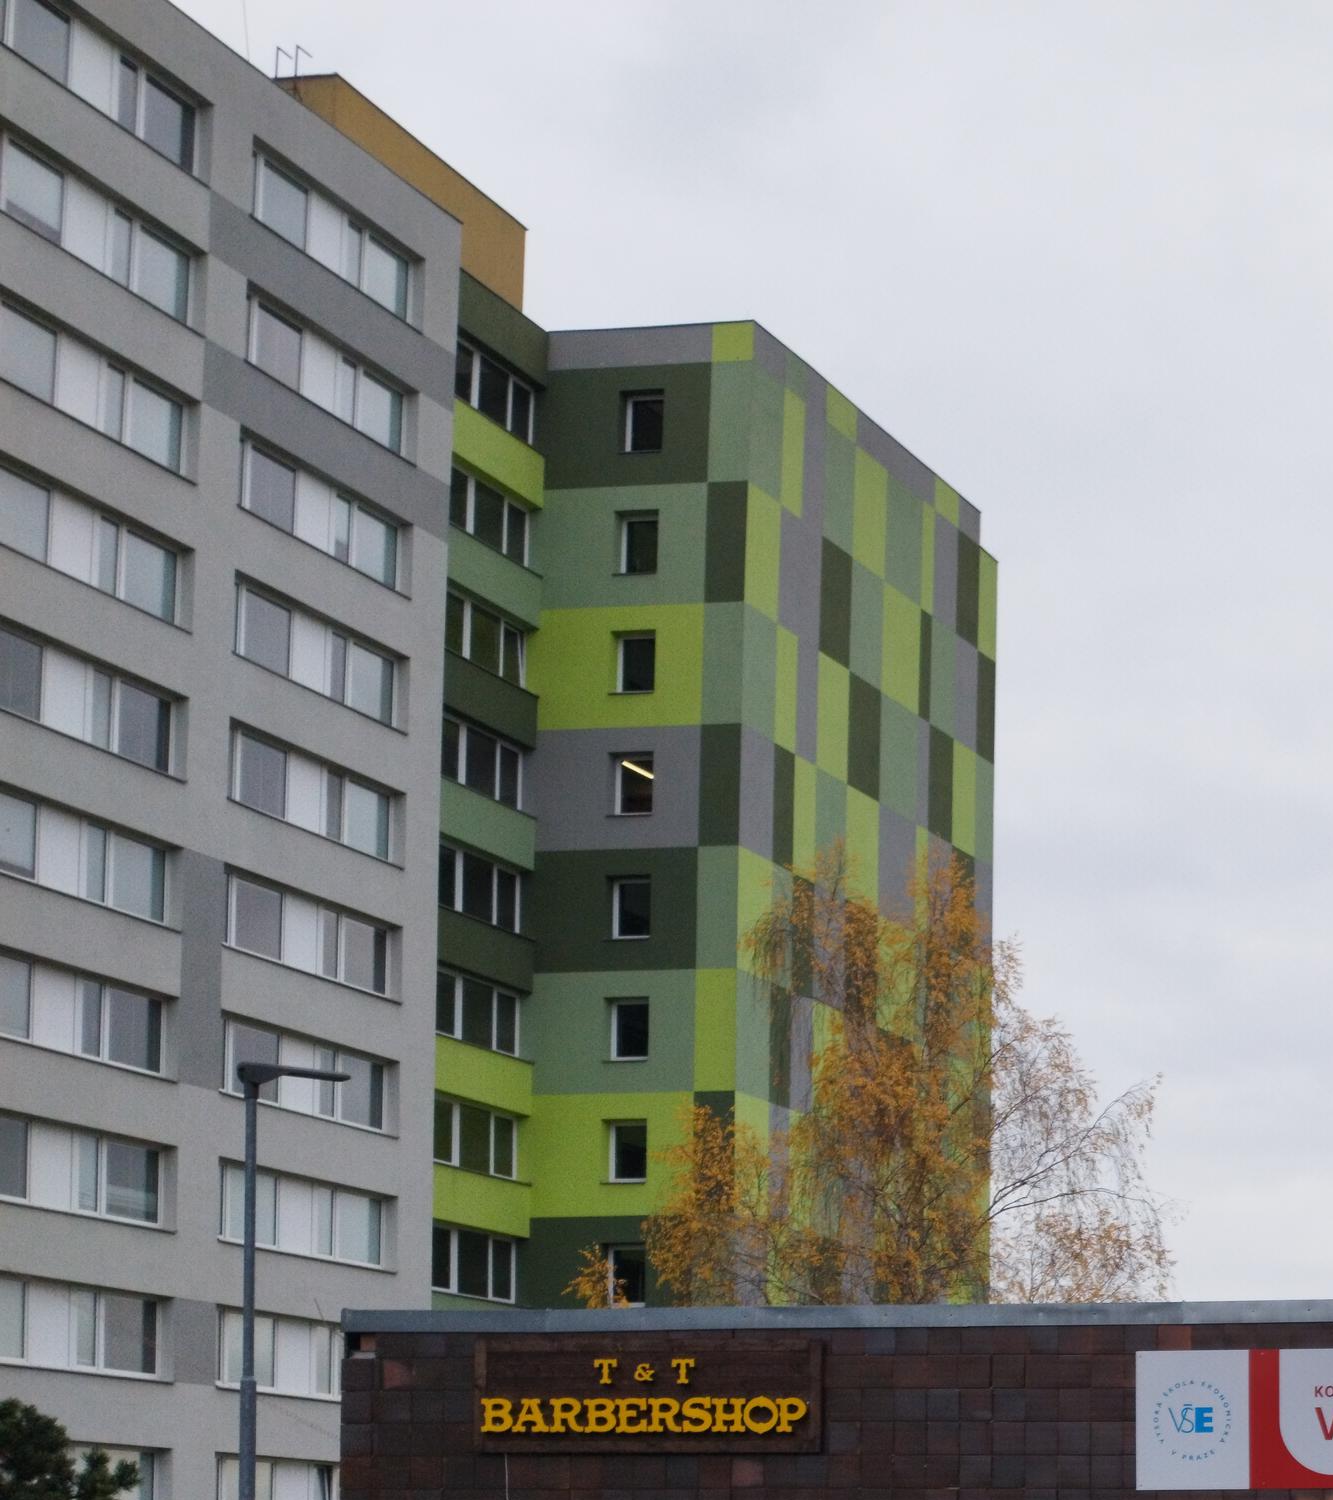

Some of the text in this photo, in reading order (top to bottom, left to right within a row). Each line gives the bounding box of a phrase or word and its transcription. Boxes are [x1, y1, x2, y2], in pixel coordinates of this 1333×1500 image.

[593, 1357, 696, 1385] T & T
[480, 1395, 807, 1435] BARBERSHOP
